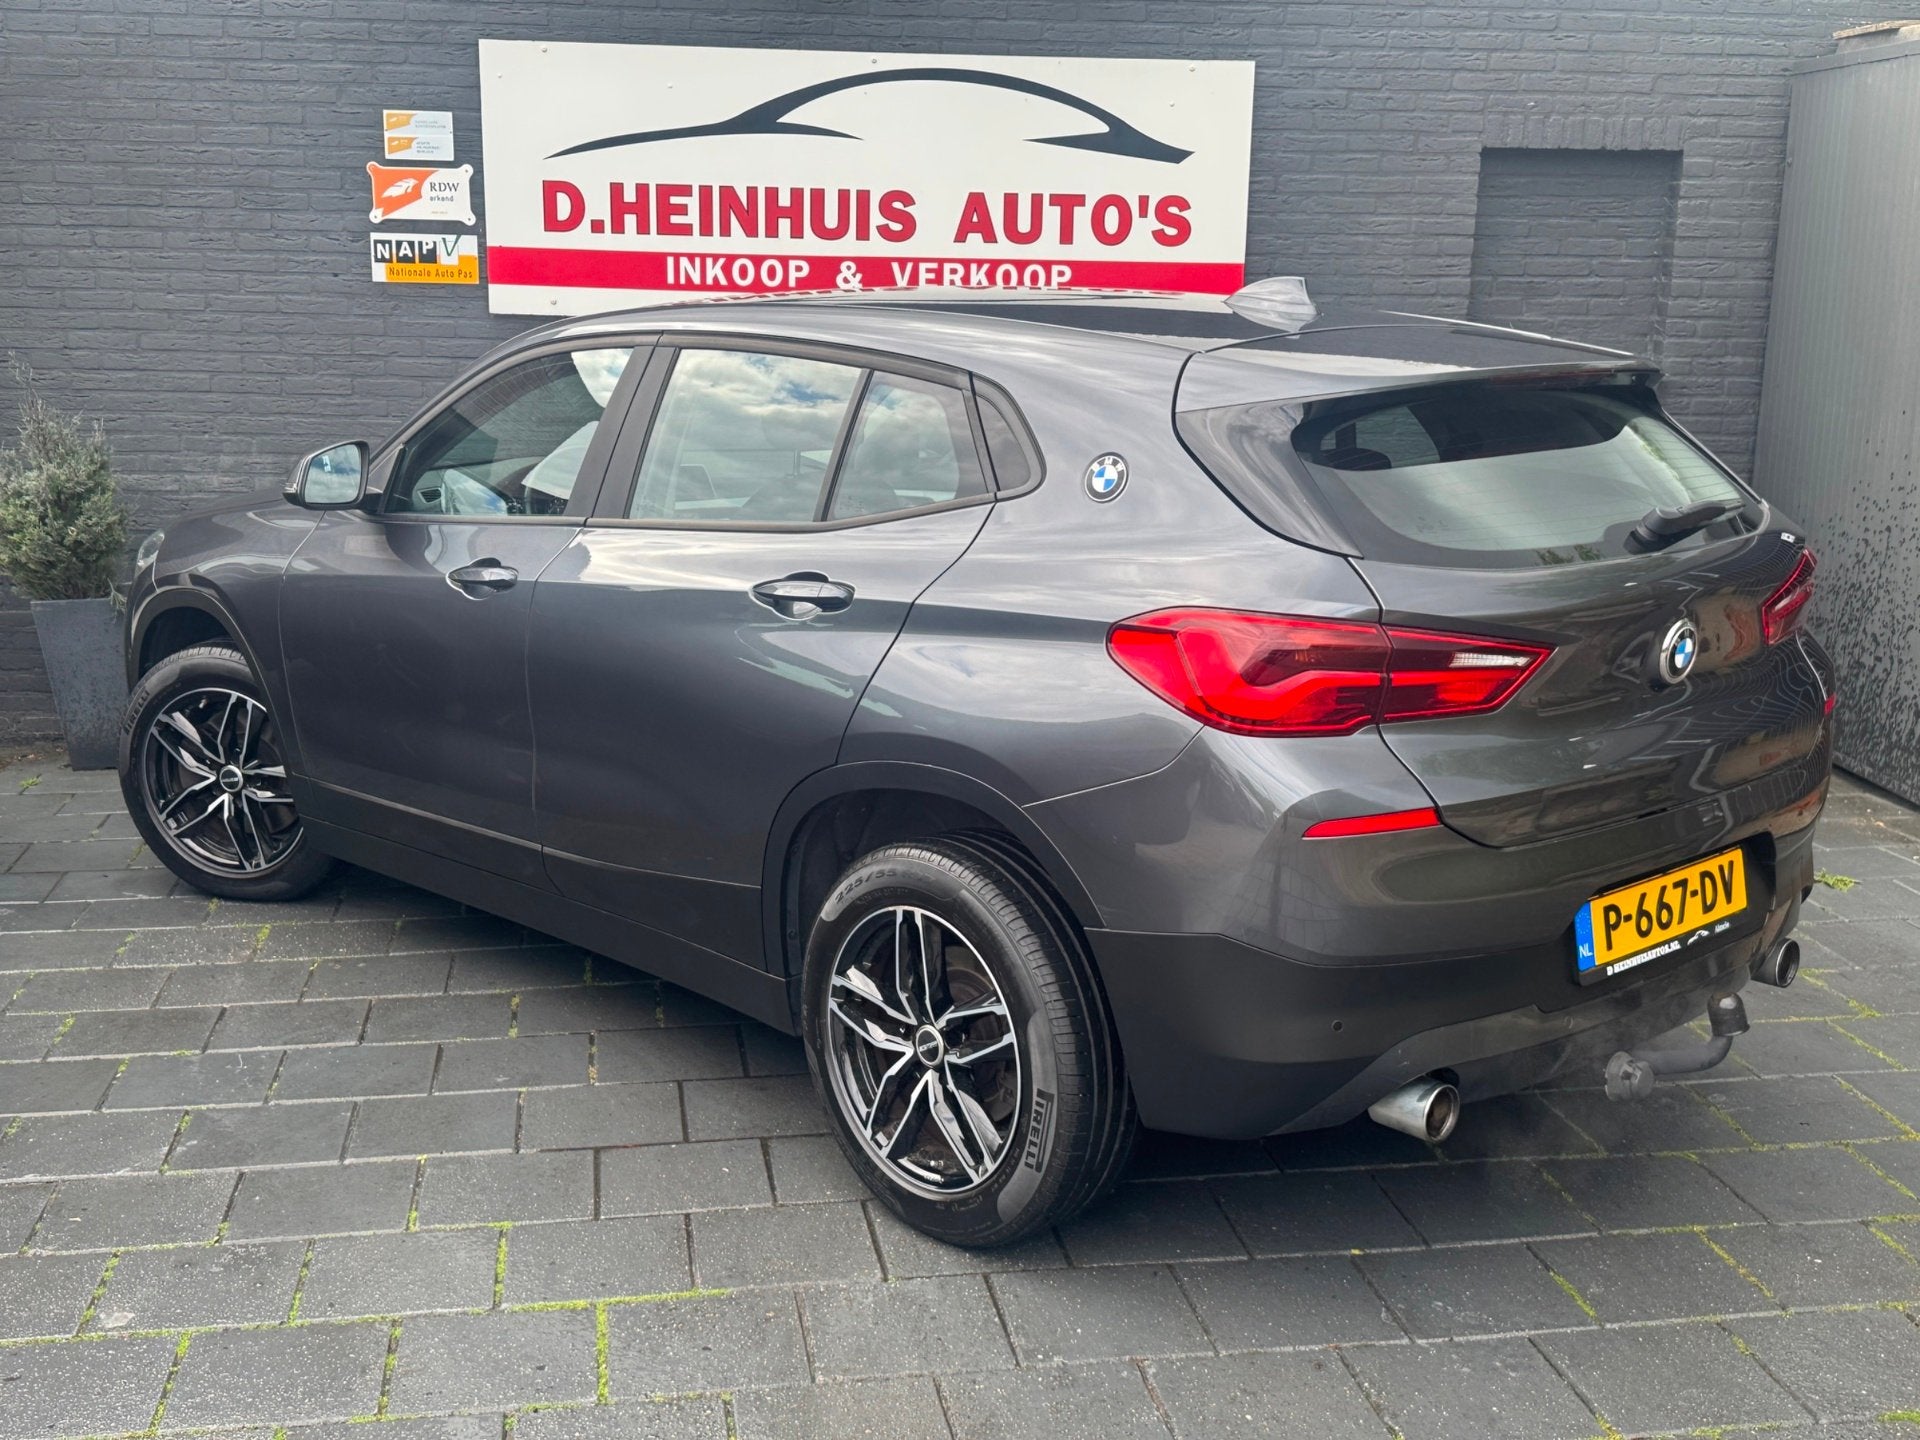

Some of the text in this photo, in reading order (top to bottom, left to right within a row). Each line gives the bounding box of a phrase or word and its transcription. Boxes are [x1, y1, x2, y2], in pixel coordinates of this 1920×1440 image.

[429, 182, 459, 192] RDW
[542, 180, 1193, 247] D.HEINHUIS AUTO'S
[389, 266, 473, 278] Nationale Auto Pas
[666, 256, 1072, 290] INKOOP & VERKOOP
[1602, 860, 1734, 951] P-667-DV
[1579, 943, 1593, 958] NL
[1023, 1088, 1055, 1174] PIRELLI
